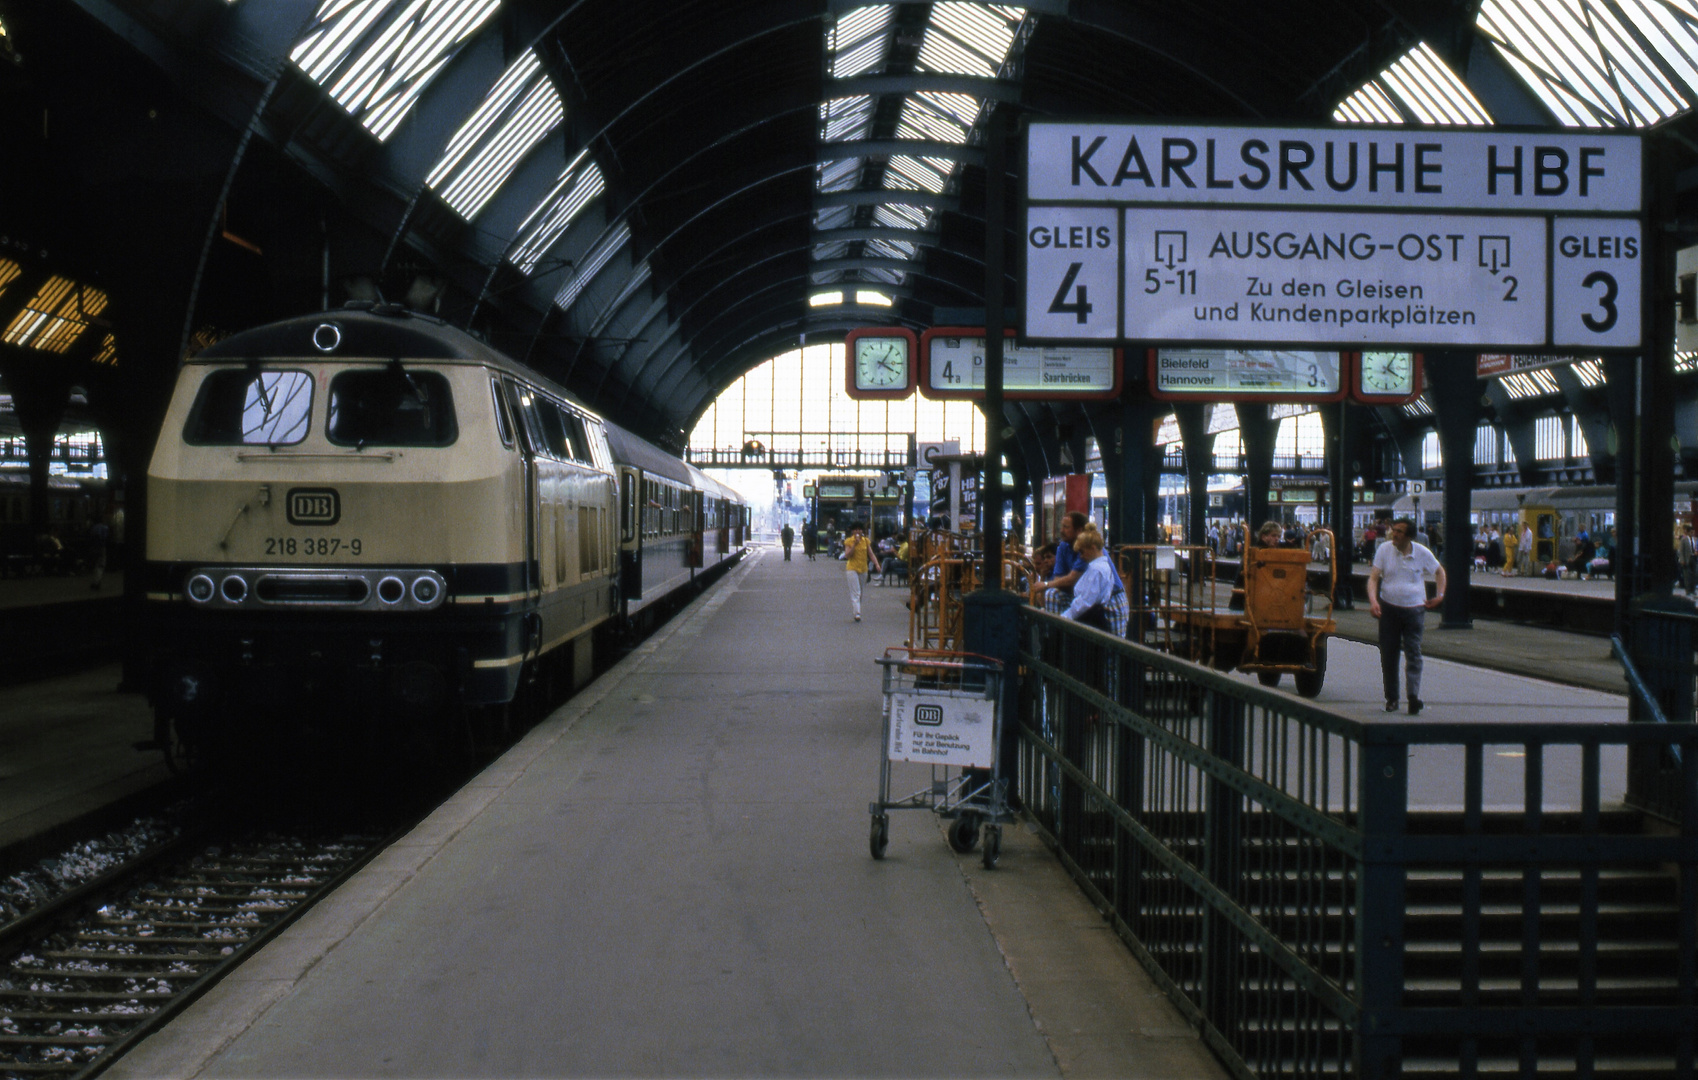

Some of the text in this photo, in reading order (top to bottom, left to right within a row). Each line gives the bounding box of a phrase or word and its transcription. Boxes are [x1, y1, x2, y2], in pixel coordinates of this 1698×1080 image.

[1071, 134, 1606, 197] KARLSRUHE HBF
[1029, 226, 1111, 249] GLEIS
[1208, 231, 1465, 262] AUSGANG-OST
[1559, 235, 1639, 260] GLEIS
[1144, 268, 1197, 295] 5-11
[1246, 276, 1424, 299] Zu den Gleisen
[1502, 275, 1519, 302] 2
[1047, 262, 1093, 325] 4
[1581, 270, 1619, 333] 3
[1194, 302, 1476, 329] und Kundenparkplätzen
[973, 355, 983, 366] D
[1161, 358, 1210, 369] Bielefeld
[1043, 371, 1091, 384] Saarbrücken
[1160, 374, 1216, 386] Hannover
[924, 445, 940, 465] C
[867, 478, 875, 489] D
[1413, 483, 1422, 493] D
[265, 537, 362, 556] 218 387-9
[912, 730, 924, 738] Für
[935, 732, 960, 741] Gepäck
[922, 748, 949, 756] Bahnhof
[936, 741, 971, 751] Benutzung
